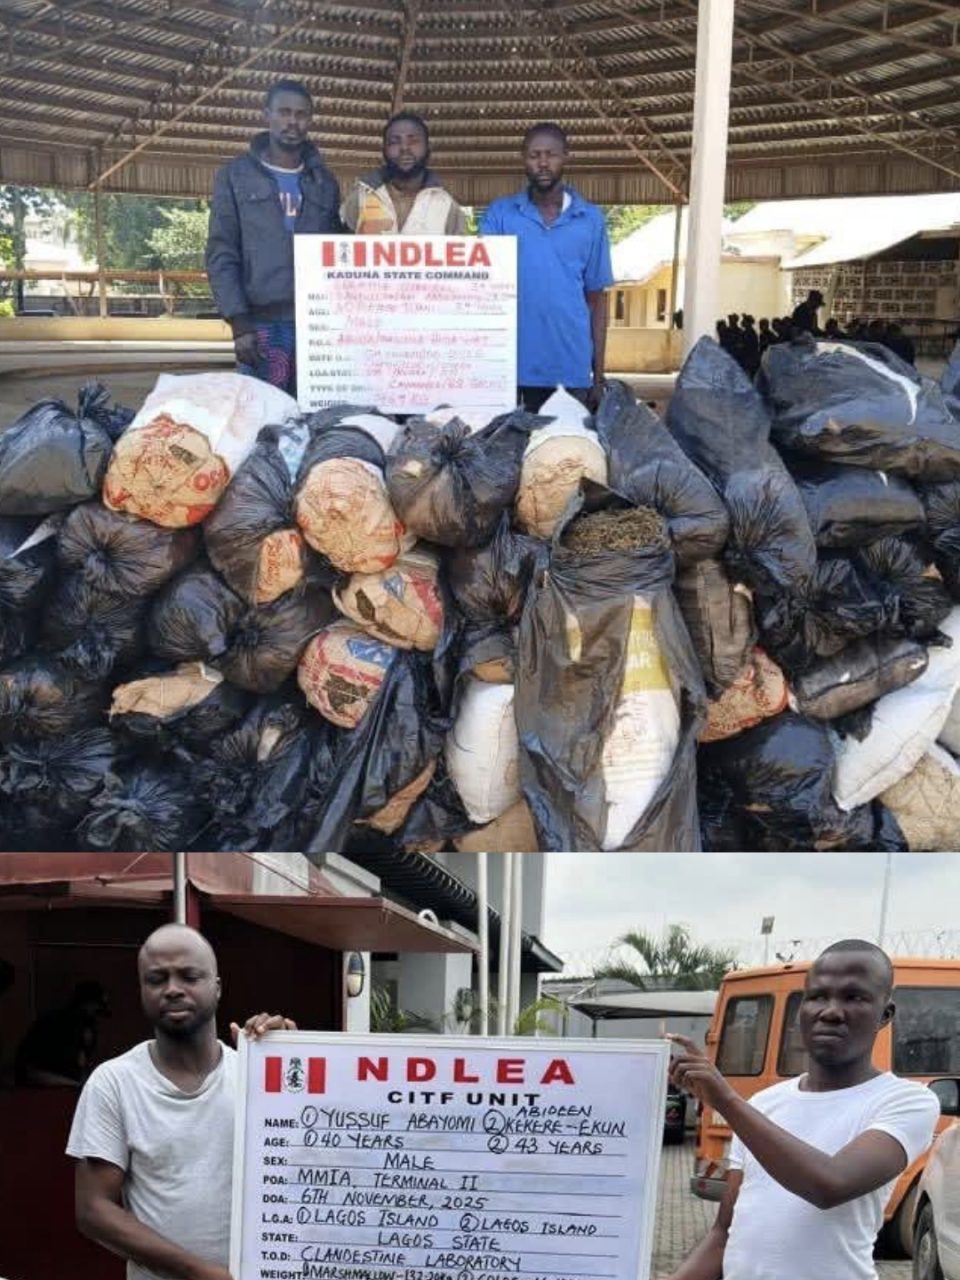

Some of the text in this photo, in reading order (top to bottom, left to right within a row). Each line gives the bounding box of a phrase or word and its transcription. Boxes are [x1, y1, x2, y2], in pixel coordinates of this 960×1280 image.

[373, 241, 492, 267] NDLEA
[327, 271, 490, 281] KADUNA STATE COMMAND
[357, 1057, 576, 1085] NDLEA
[387, 1091, 541, 1107] CITF UNIT
[264, 1118, 300, 1129] NAME:
[263, 1136, 290, 1147] AGE:
[347, 1132, 405, 1149] YEARS
[515, 1137, 539, 1154] 43
[548, 1140, 603, 1155] YEARS
[262, 1152, 436, 1170] SEX: MALE
[262, 1175, 289, 1185] POA:
[374, 1172, 450, 1189] TERMINAL
[262, 1194, 289, 1204] DOA:
[301, 1188, 330, 1205] 6TH
[441, 1196, 489, 1210] 2025
[379, 1209, 439, 1228] ISLAND
[541, 1222, 598, 1235] ISLAND
[262, 1231, 501, 1251] STATE: LAGOS STATE
[301, 1246, 406, 1264] CLANDESTINE
[425, 1254, 522, 1272] LABORATORY
